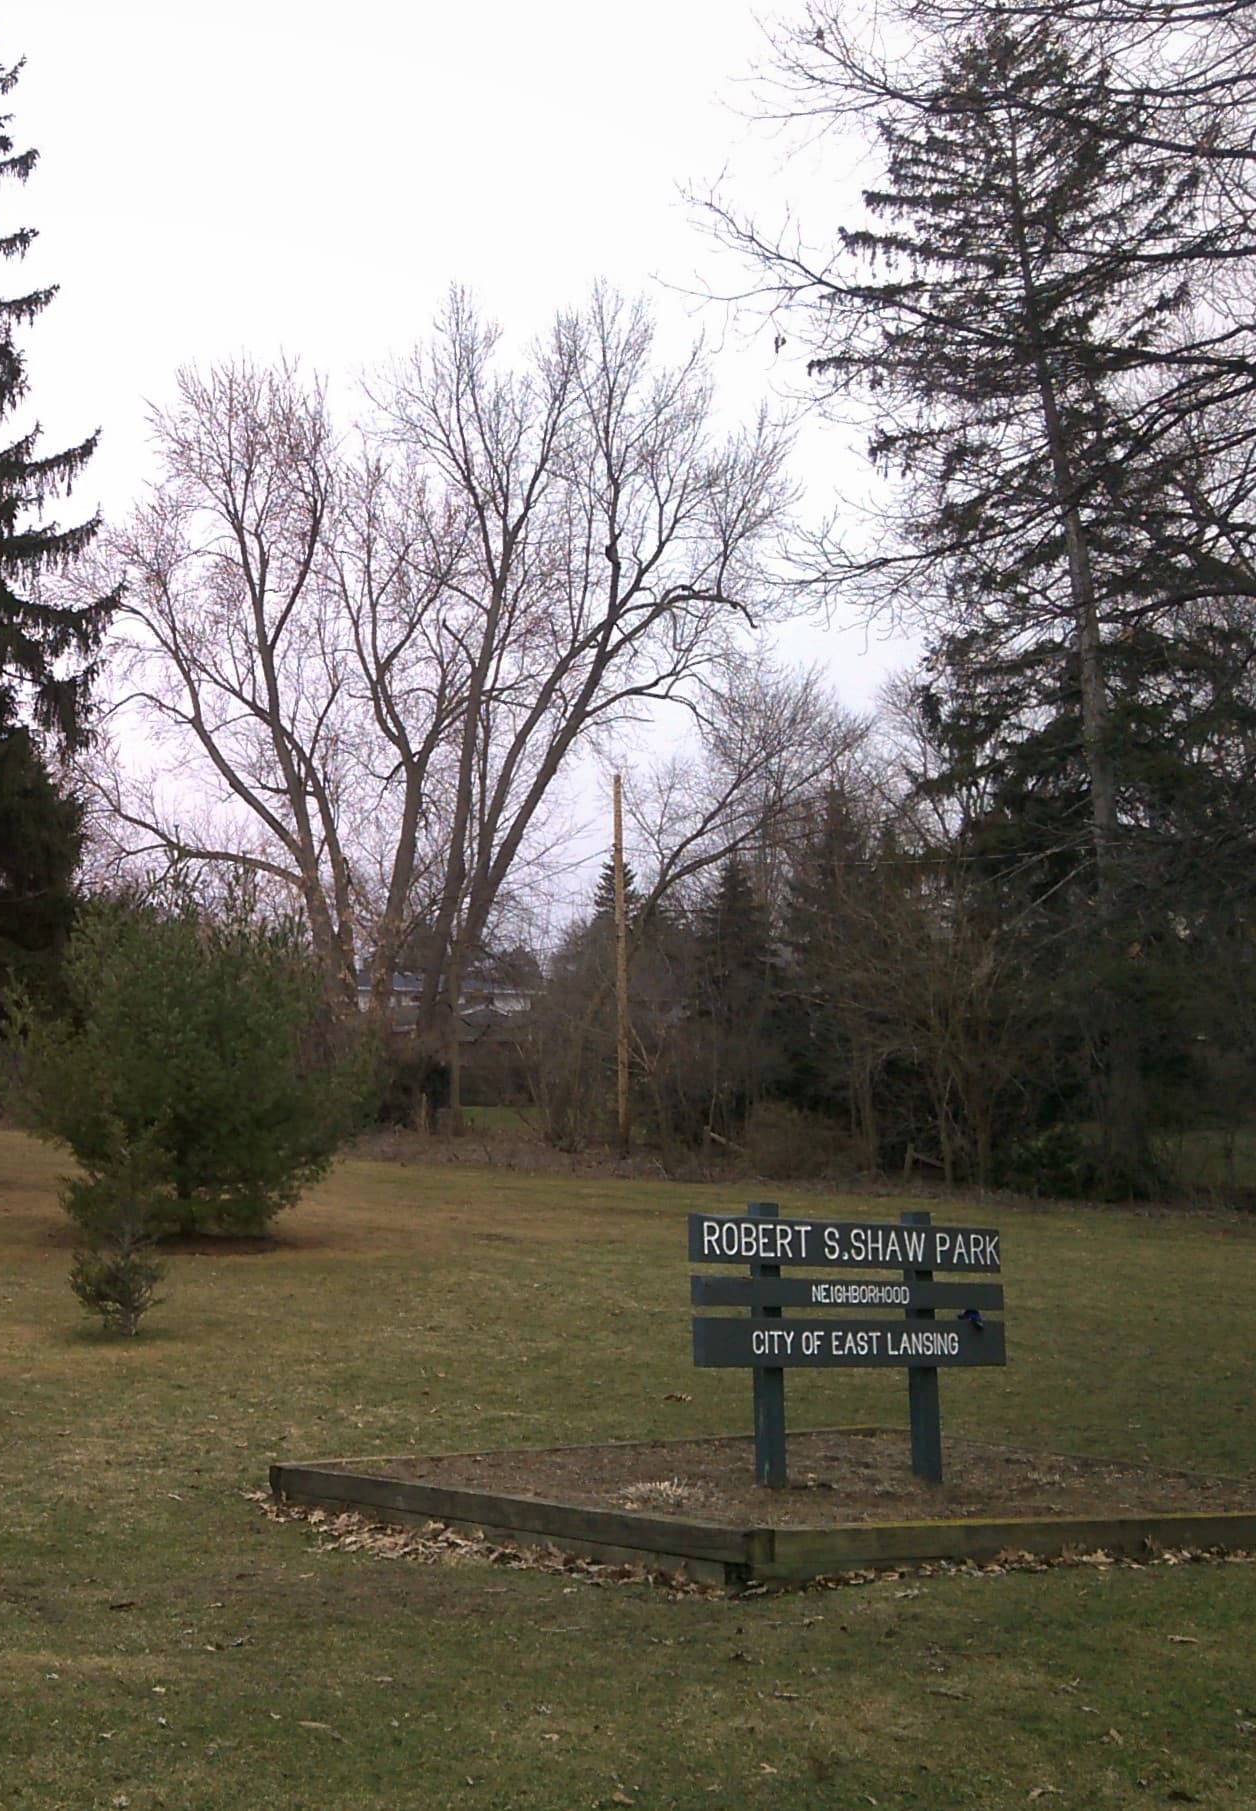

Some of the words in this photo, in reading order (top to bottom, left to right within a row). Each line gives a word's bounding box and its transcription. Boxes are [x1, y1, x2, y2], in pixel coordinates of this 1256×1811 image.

[704, 1221, 812, 1258] ROBERT
[935, 1233, 1000, 1265] PARK
[812, 1284, 910, 1305] NEIGHBORHOOD
[752, 1330, 795, 1355] CITY
[802, 1331, 825, 1355] OF
[832, 1332, 881, 1355] EAST
[887, 1332, 959, 1356] LANSING
